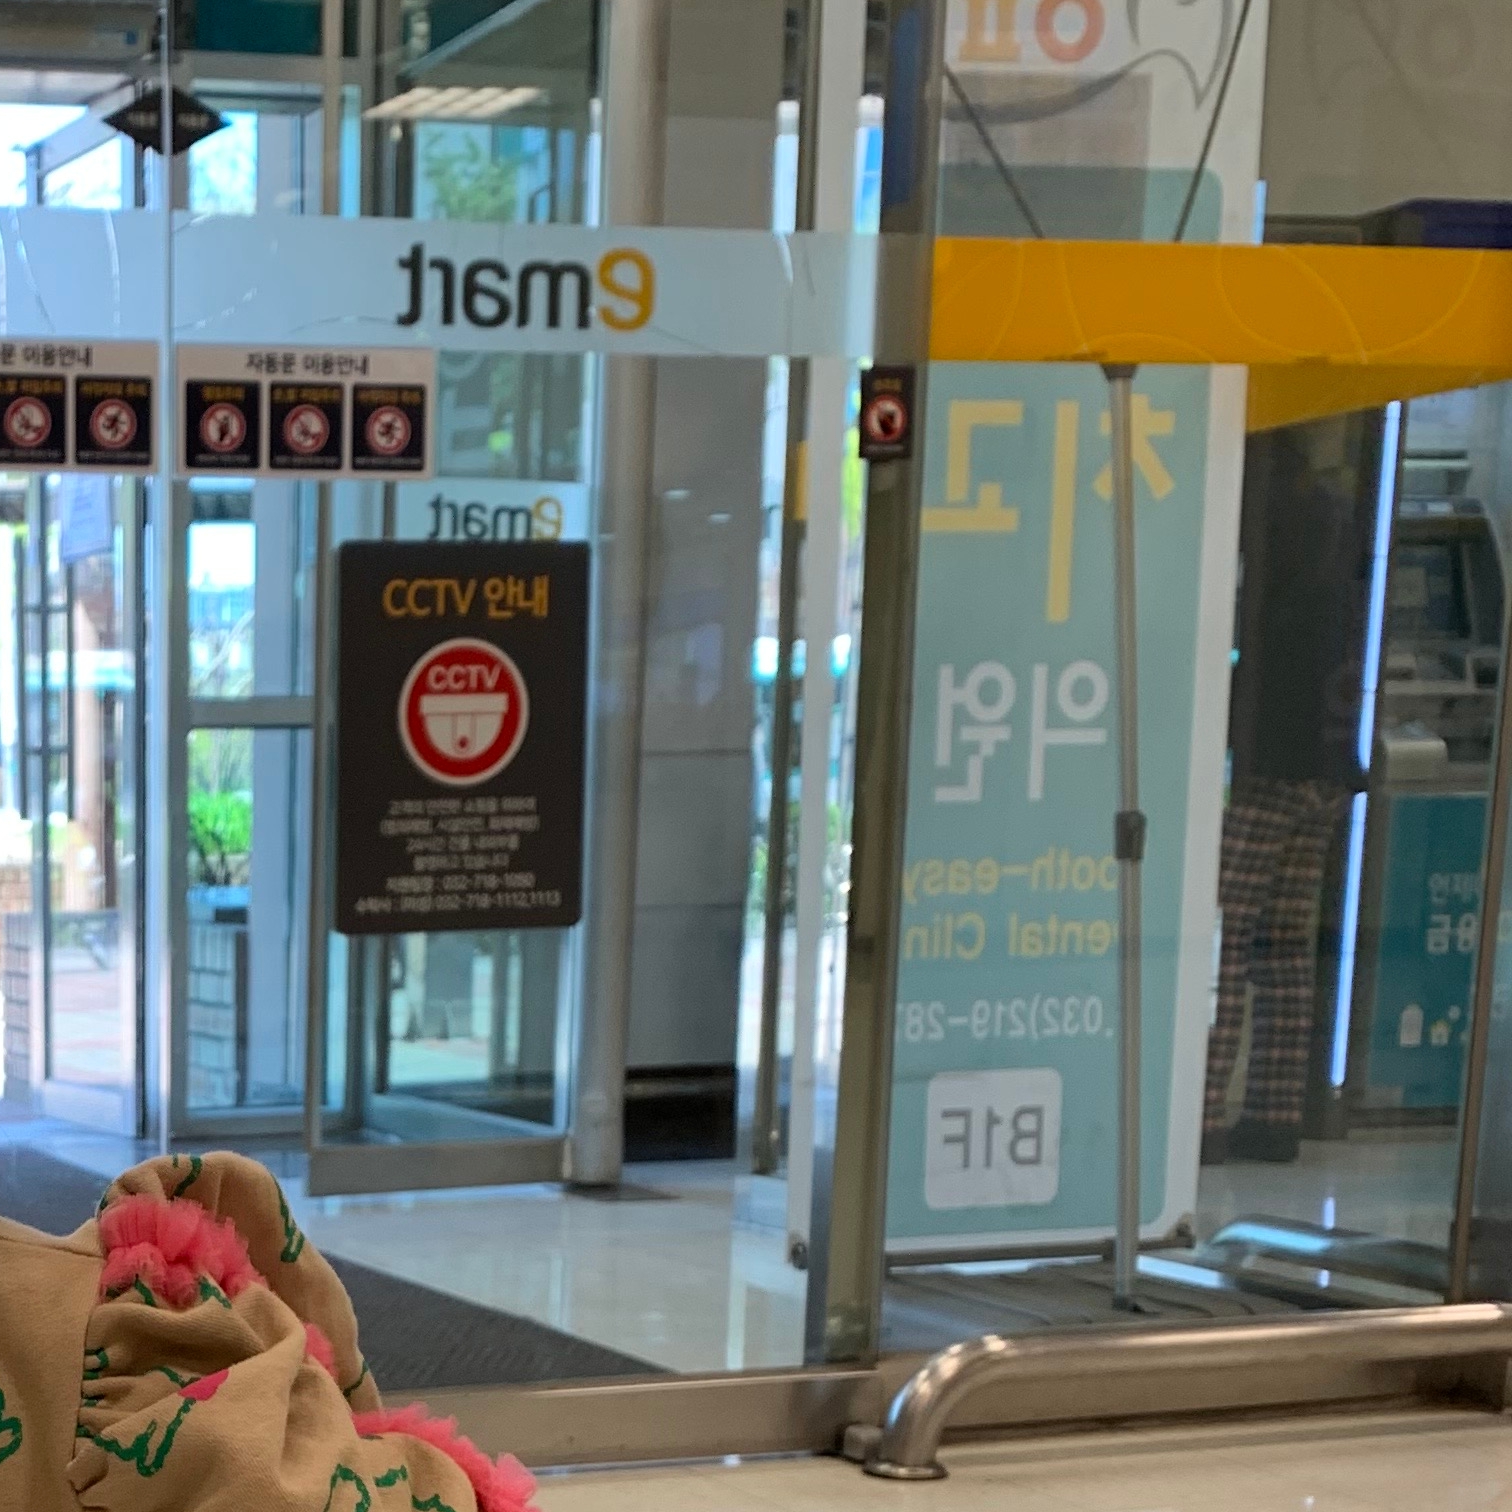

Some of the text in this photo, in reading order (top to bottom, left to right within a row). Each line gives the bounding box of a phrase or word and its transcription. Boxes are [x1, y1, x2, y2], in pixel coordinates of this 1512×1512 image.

[22, 344, 94, 368] 이용안내
[246, 352, 370, 376] 자동문 이용안내
[382, 574, 550, 619] CCTV 안내
[427, 664, 502, 691] CCTV
